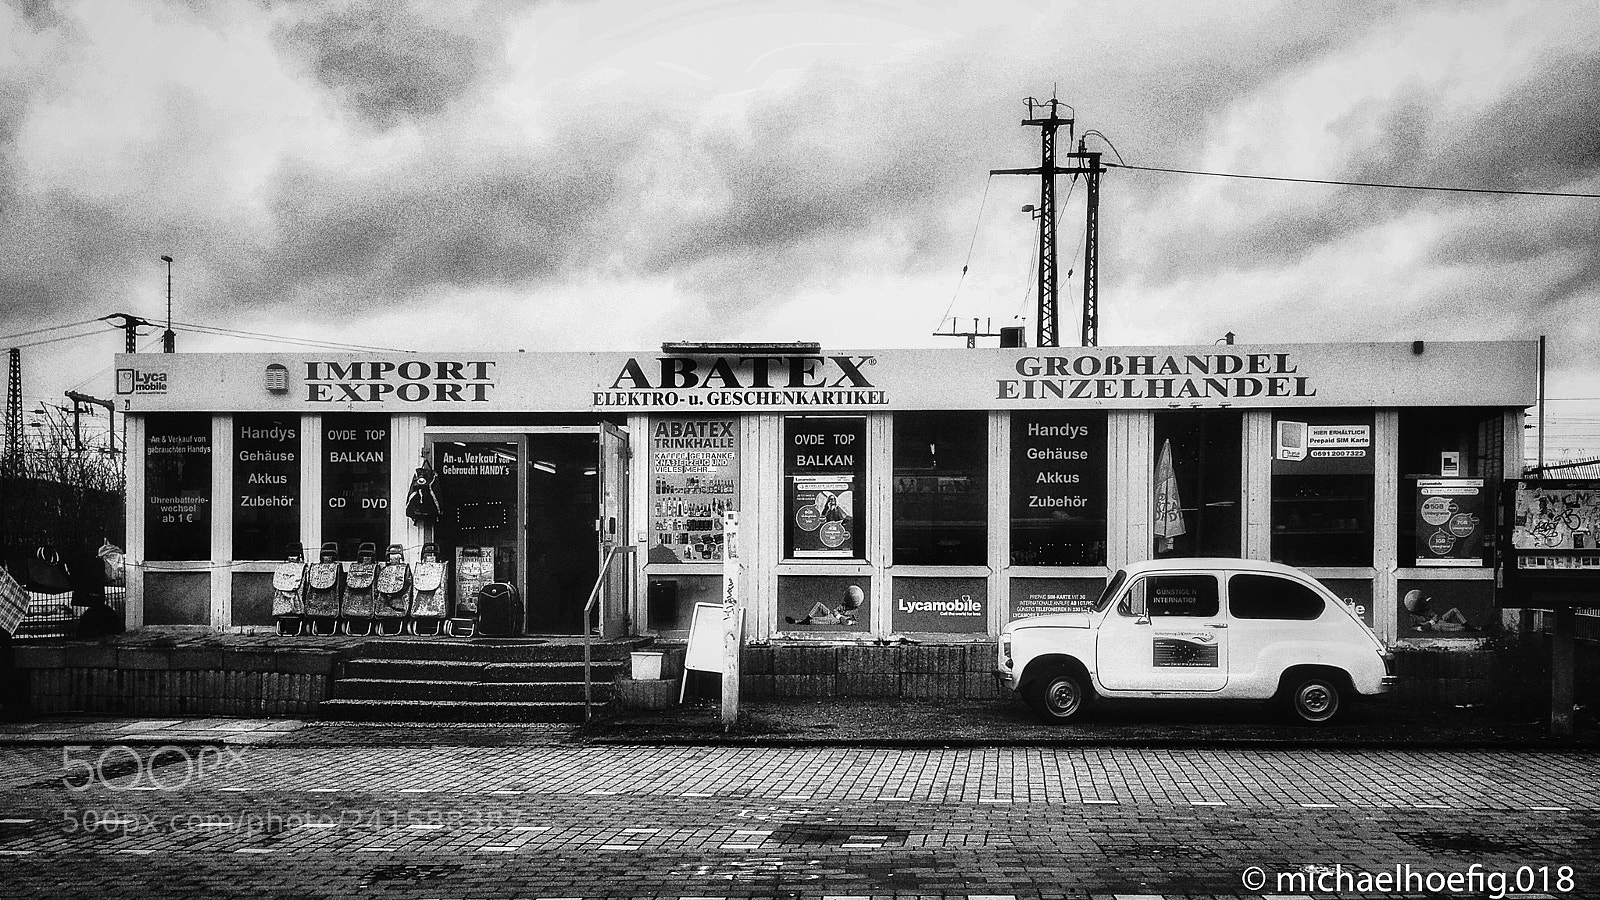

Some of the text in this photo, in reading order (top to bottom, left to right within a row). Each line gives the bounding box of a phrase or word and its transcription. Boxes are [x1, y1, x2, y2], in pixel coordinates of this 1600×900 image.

[304, 361, 496, 381] IMPORT
[1015, 353, 1298, 377] GROßHANDEL
[135, 370, 167, 385] Lyca
[135, 382, 167, 391] mobile
[304, 383, 495, 402] EXPORT
[995, 376, 1317, 400] EINZELHANDEL
[707, 389, 890, 406] GESCHENKARTIKEL
[241, 426, 296, 442] Handys
[328, 430, 386, 441] OVDE TOP
[654, 421, 734, 438] ABATEX
[1028, 422, 1089, 439] Handys
[161, 435, 167, 443] &
[168, 435, 193, 443] Verkauf
[653, 438, 734, 448] TRINKHALLE
[794, 434, 855, 445] OVDE TOP
[147, 445, 211, 455] gebrauchten Handys
[239, 450, 295, 461] Gehäuse
[1027, 447, 1088, 460] Gehäuse
[330, 452, 384, 463] BALKAN
[464, 452, 498, 464] Verkauf
[711, 459, 728, 467] UND
[796, 454, 853, 466] BALKAN
[442, 464, 478, 475] Gebraucht
[248, 472, 288, 484] Akkus
[1036, 471, 1080, 484] Akkus
[150, 496, 208, 504] Uhrenbatterie-
[240, 495, 294, 507] Zubehör
[328, 497, 388, 509] CD DVD
[1028, 495, 1088, 507] Zubehör
[160, 504, 196, 512] wechsel
[162, 513, 193, 523] ab 1 €
[898, 595, 982, 614] Lycamobile
